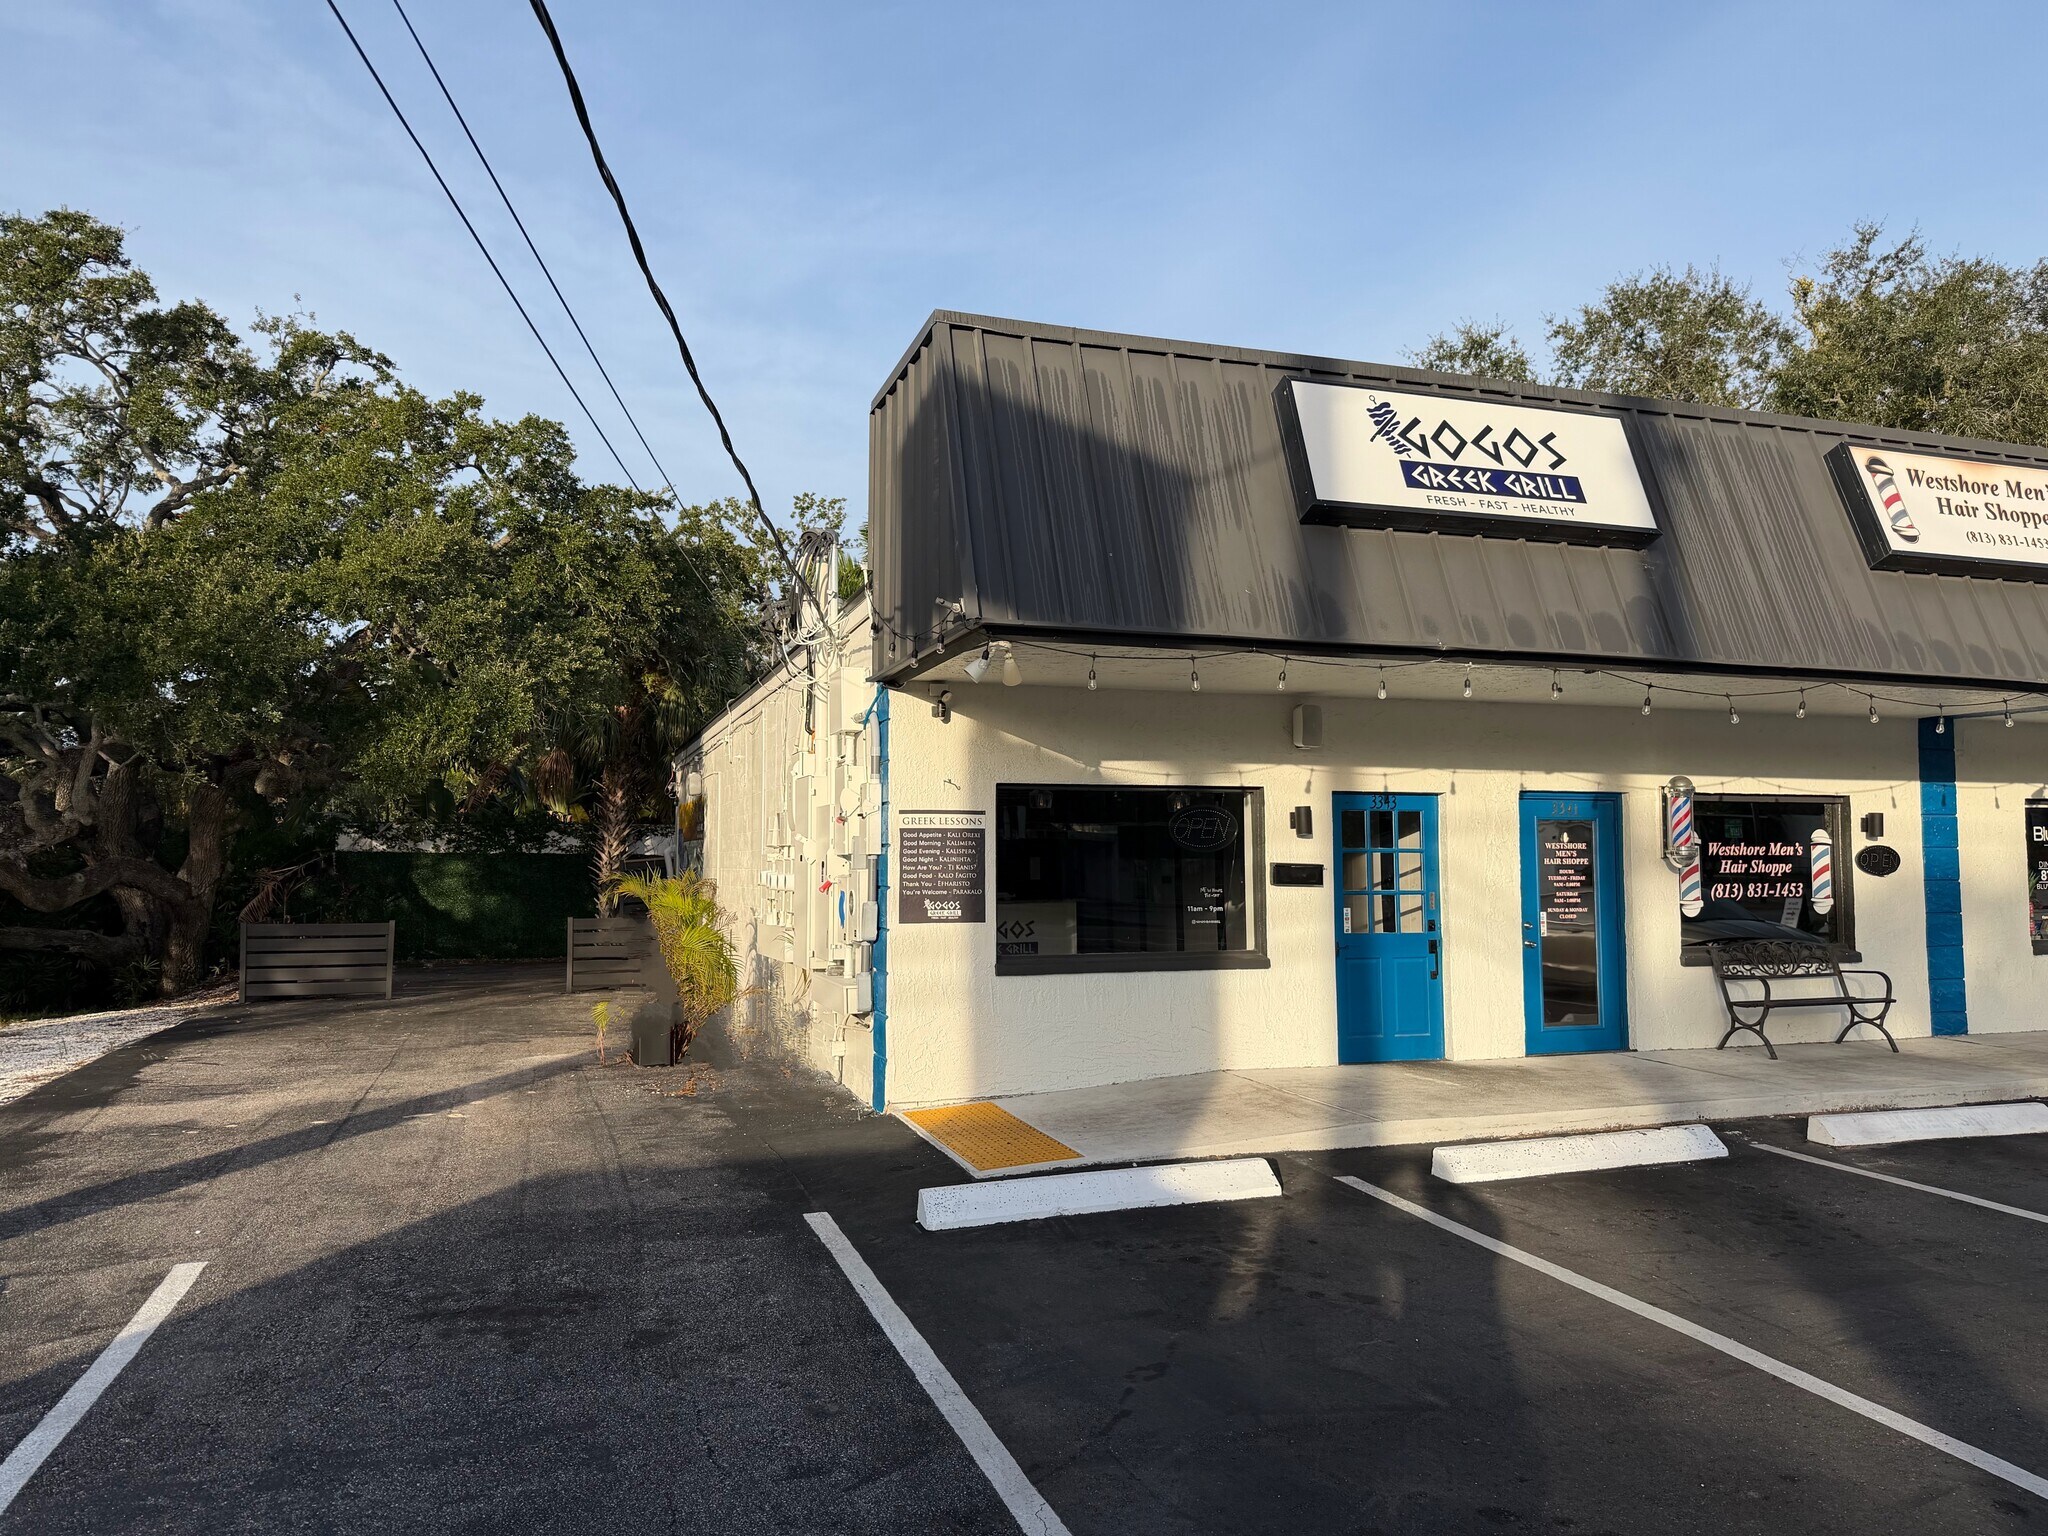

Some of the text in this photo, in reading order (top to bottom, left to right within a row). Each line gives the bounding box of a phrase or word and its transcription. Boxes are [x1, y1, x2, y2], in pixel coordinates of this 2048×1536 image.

[1397, 417, 1567, 470] GOGOS
[1412, 464, 1577, 500] GREEK GRILL
[1906, 468, 2000, 496] Westshore
[1426, 495, 1467, 507] FRESH
[1479, 499, 1509, 511] FAST
[1523, 503, 1576, 517] HEALTHY
[1936, 496, 2048, 529] Hair Shoppe
[1966, 530, 1996, 546] (813)
[1370, 794, 1397, 810] 3343
[902, 816, 982, 826] GREEK LESSONS
[1174, 817, 1231, 839] OPEN
[1708, 842, 1803, 856] Westshore Men's
[1719, 860, 1792, 876] Hair Shoppe
[1860, 852, 1898, 868] OPEN
[1710, 882, 1803, 901] (813) 831-1453
[929, 901, 960, 910] GOGOS
[1007, 944, 1035, 954] GRILL
